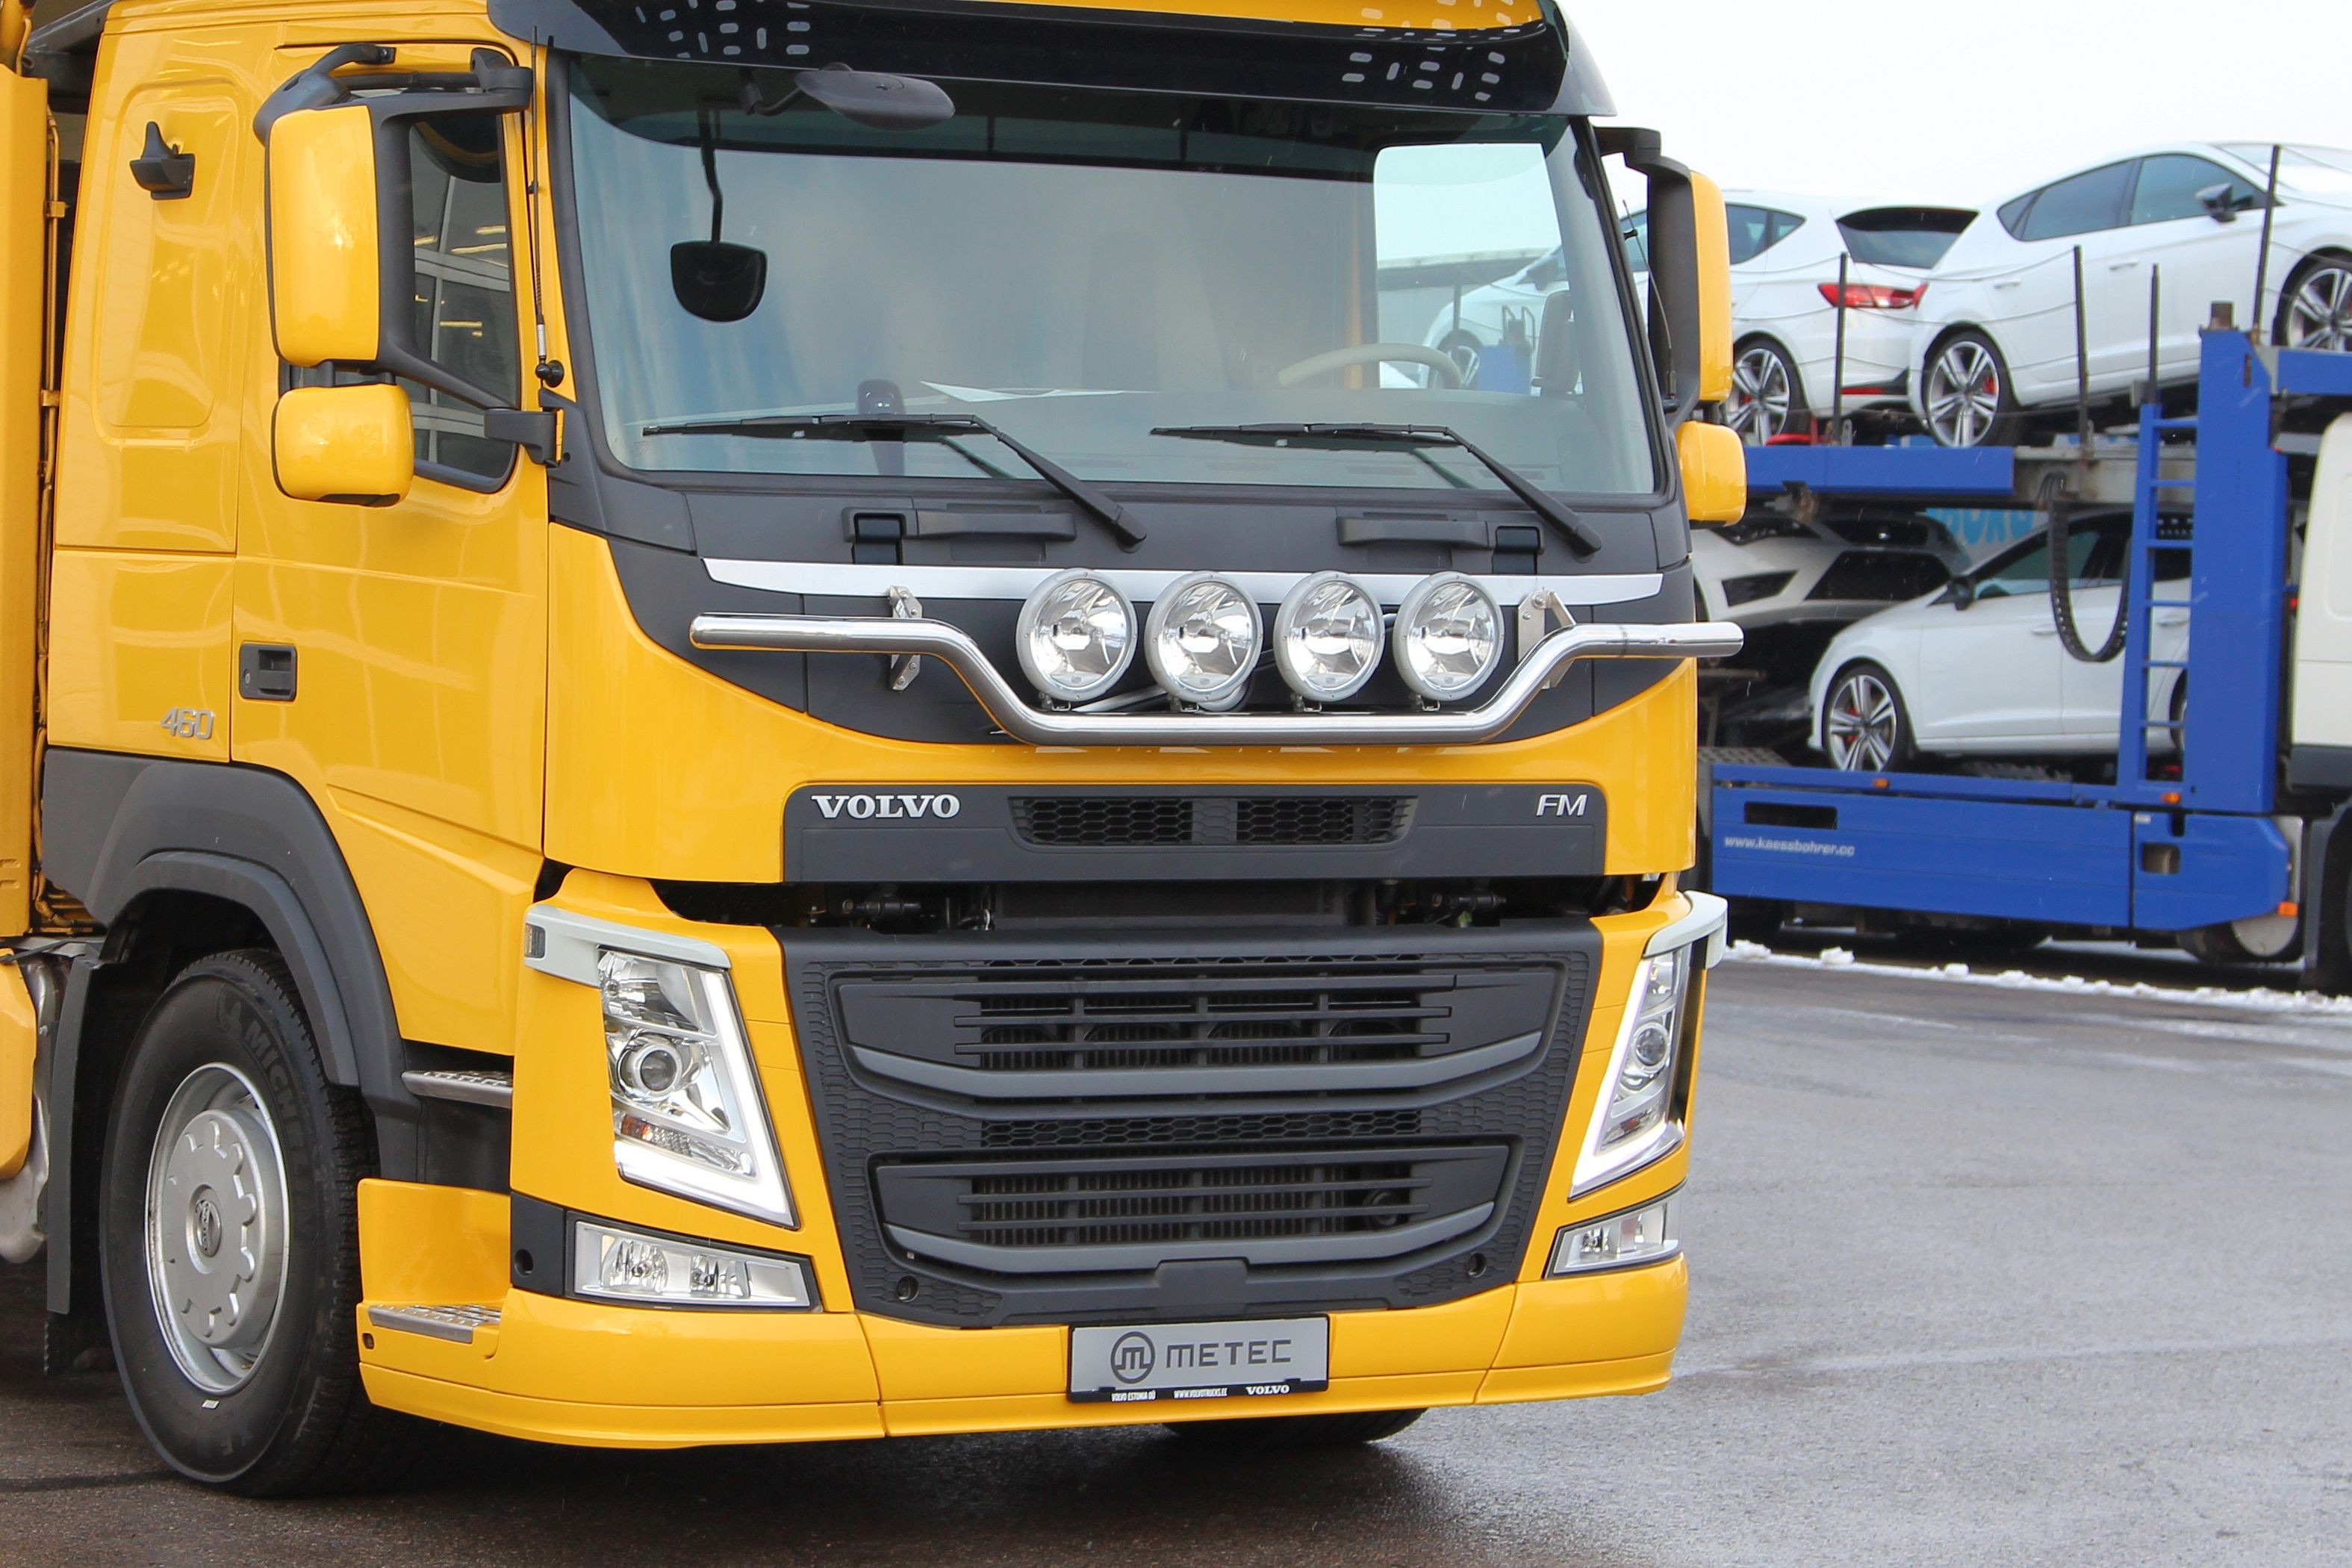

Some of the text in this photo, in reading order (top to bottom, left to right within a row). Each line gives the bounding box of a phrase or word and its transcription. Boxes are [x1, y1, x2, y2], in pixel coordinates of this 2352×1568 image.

[160, 706, 215, 739] 460
[811, 794, 961, 819] VOLVO
[1536, 794, 1588, 817] FM
[1166, 1339, 1292, 1369] METEC
[1111, 1392, 1127, 1402] VOLVO
[1245, 1384, 1291, 1396] VOLVO
